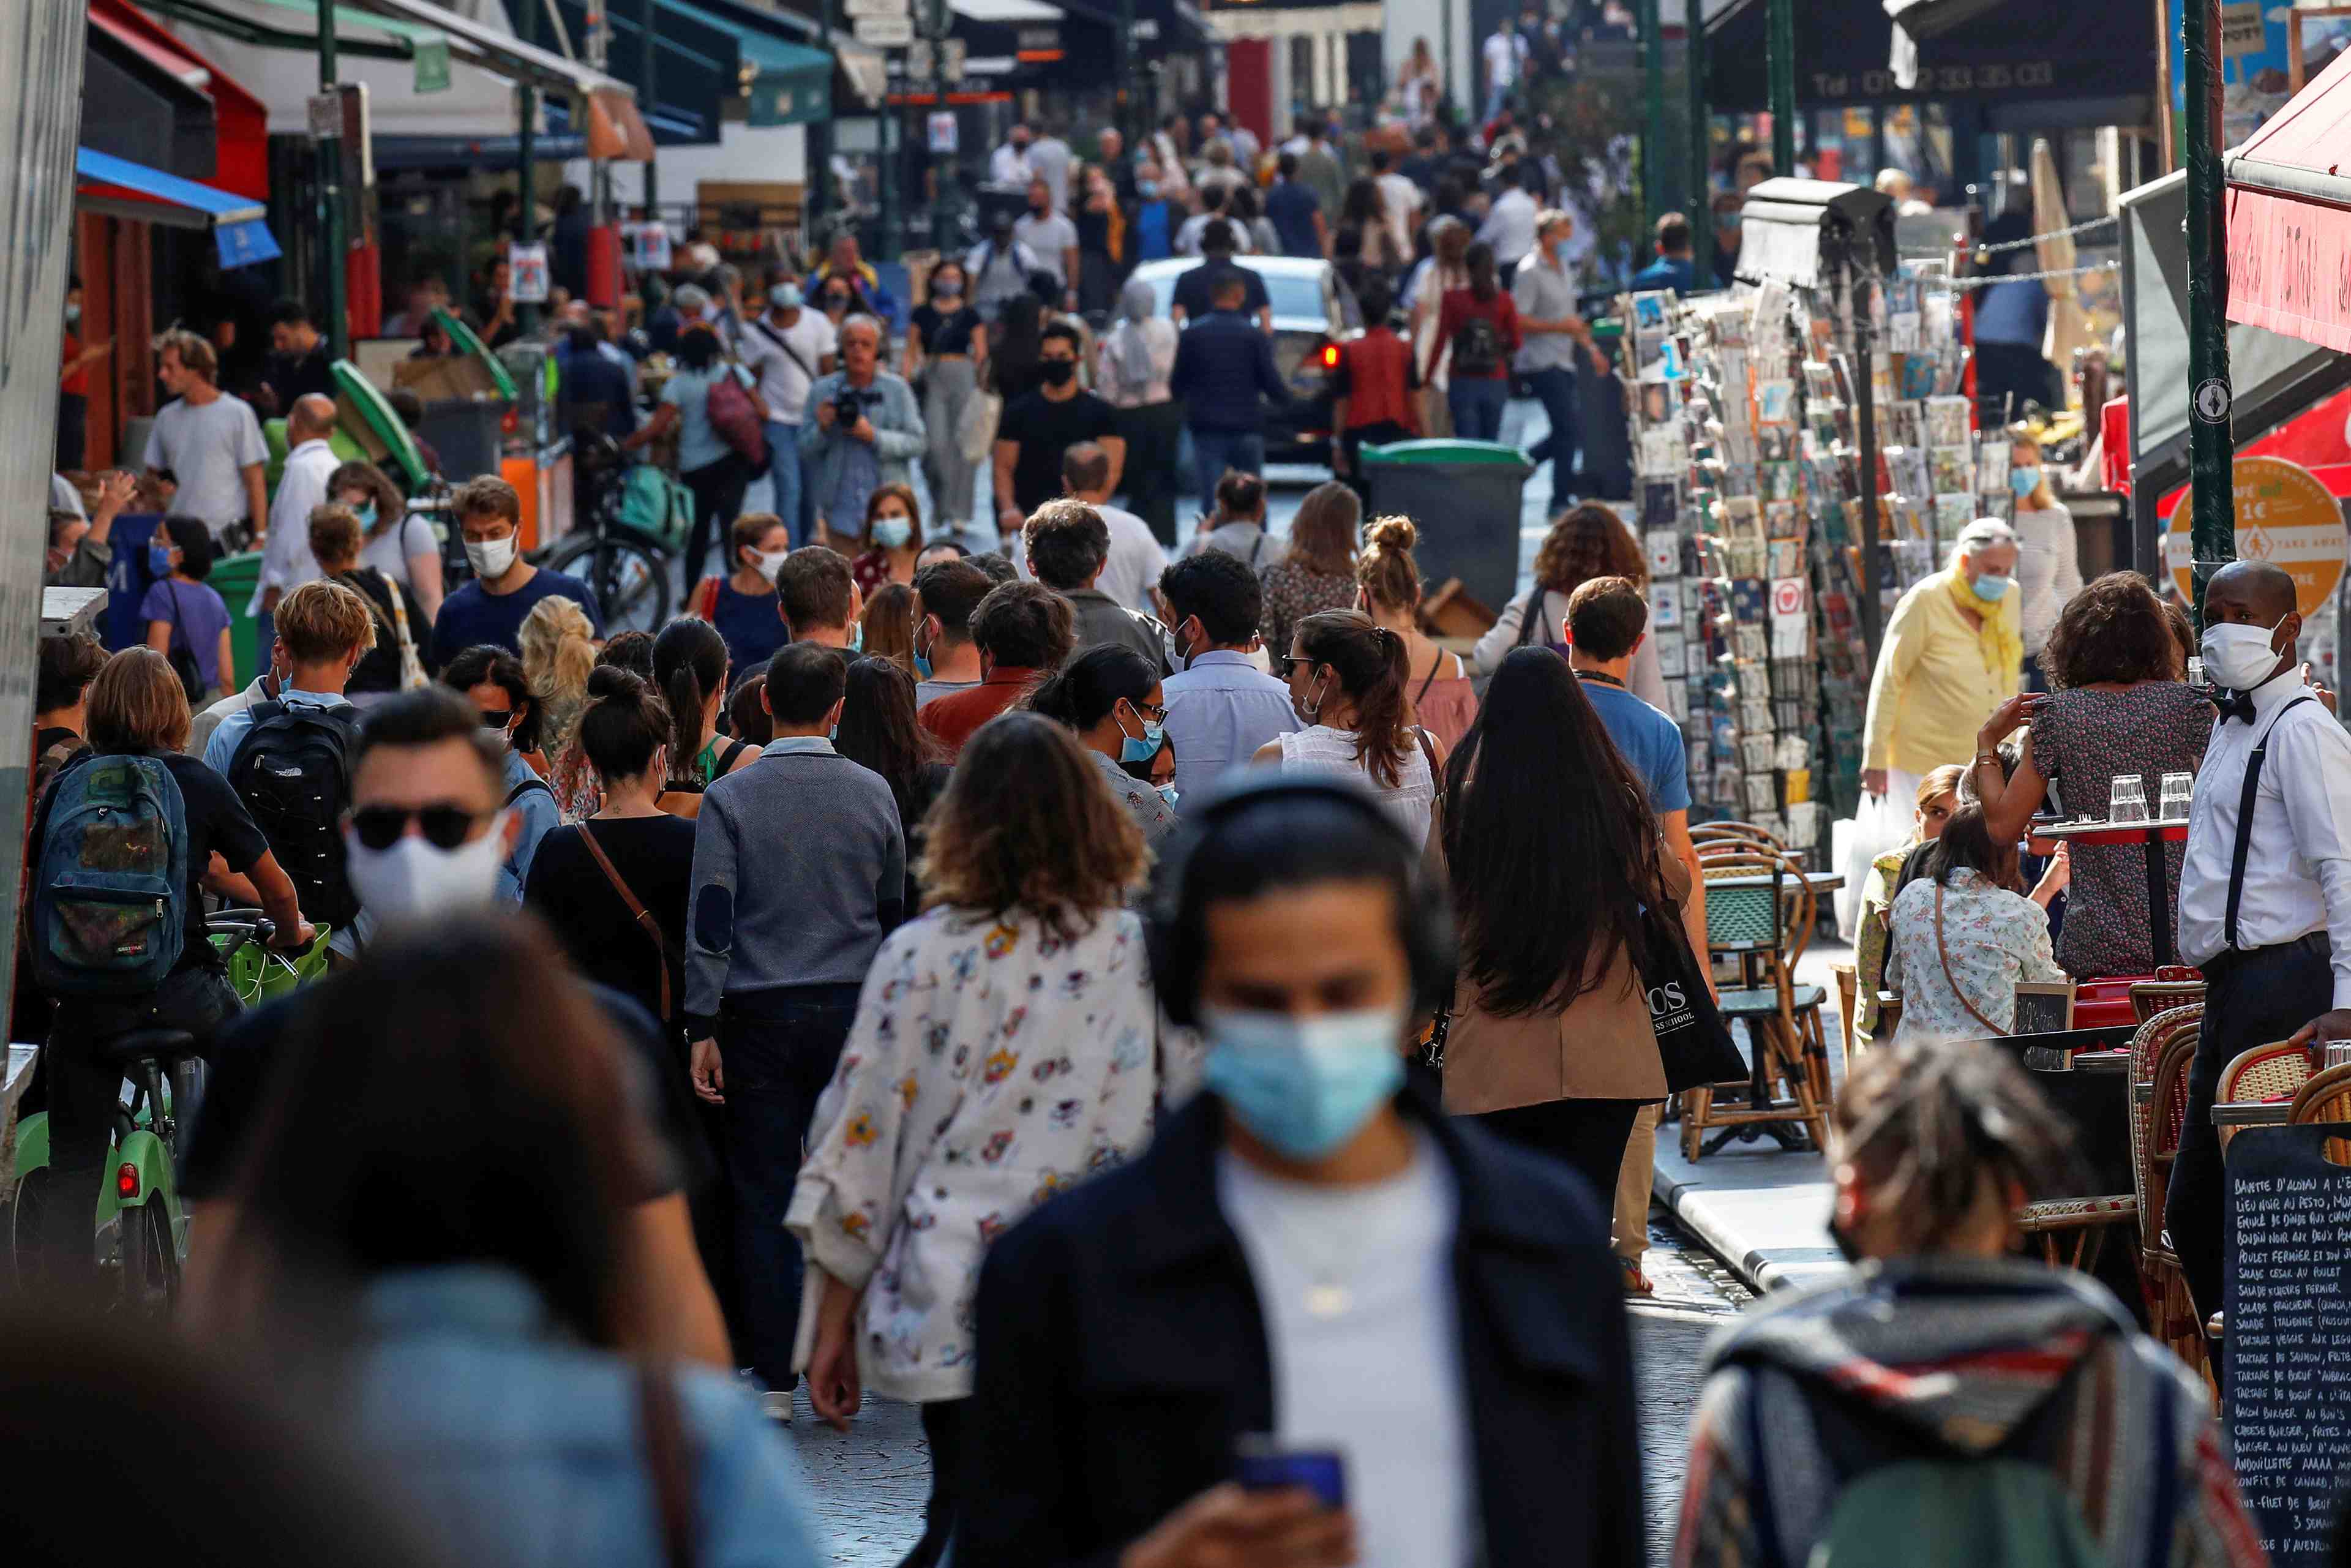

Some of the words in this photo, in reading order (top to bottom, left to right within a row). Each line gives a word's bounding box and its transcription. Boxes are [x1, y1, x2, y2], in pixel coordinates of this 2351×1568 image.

[2243, 501, 2266, 520] 1€
[1646, 980, 1685, 1015] OS
[2284, 1197, 2295, 1210] AU
[2271, 1214, 2281, 1228] DE
[2309, 1211, 2325, 1225] AUX
[2312, 1228, 2333, 1244] DEUX
[2238, 1248, 2268, 1264] POULET
[2313, 1250, 2323, 1262] ET
[2297, 1267, 2308, 1278] AU
[2313, 1266, 2341, 1277] POULET
[2238, 1285, 2266, 1297] SALADE
[2238, 1302, 2267, 1315] SALADE
[2236, 1318, 2265, 1330] SALADE
[2237, 1335, 2271, 1346] TARTARE
[2311, 1334, 2327, 1344] AUX
[2235, 1353, 2268, 1364] TARTARE
[2235, 1370, 2270, 1381] TARTARE
[2274, 1370, 2284, 1383] DE
[2235, 1387, 2268, 1399] TARTARE
[2274, 1387, 2284, 1401] DE
[2235, 1403, 2259, 1417] BACON
[2263, 1406, 2297, 1420] BURGER
[2305, 1408, 2315, 1420] AU
[2235, 1425, 2265, 1437] CHEESE
[2235, 1439, 2271, 1454] BURGER
[2277, 1442, 2287, 1452] AU
[2302, 1457, 2332, 1471] AAAAA
[2287, 1496, 2300, 1510] DE
[2293, 1515, 2301, 1529] 3
